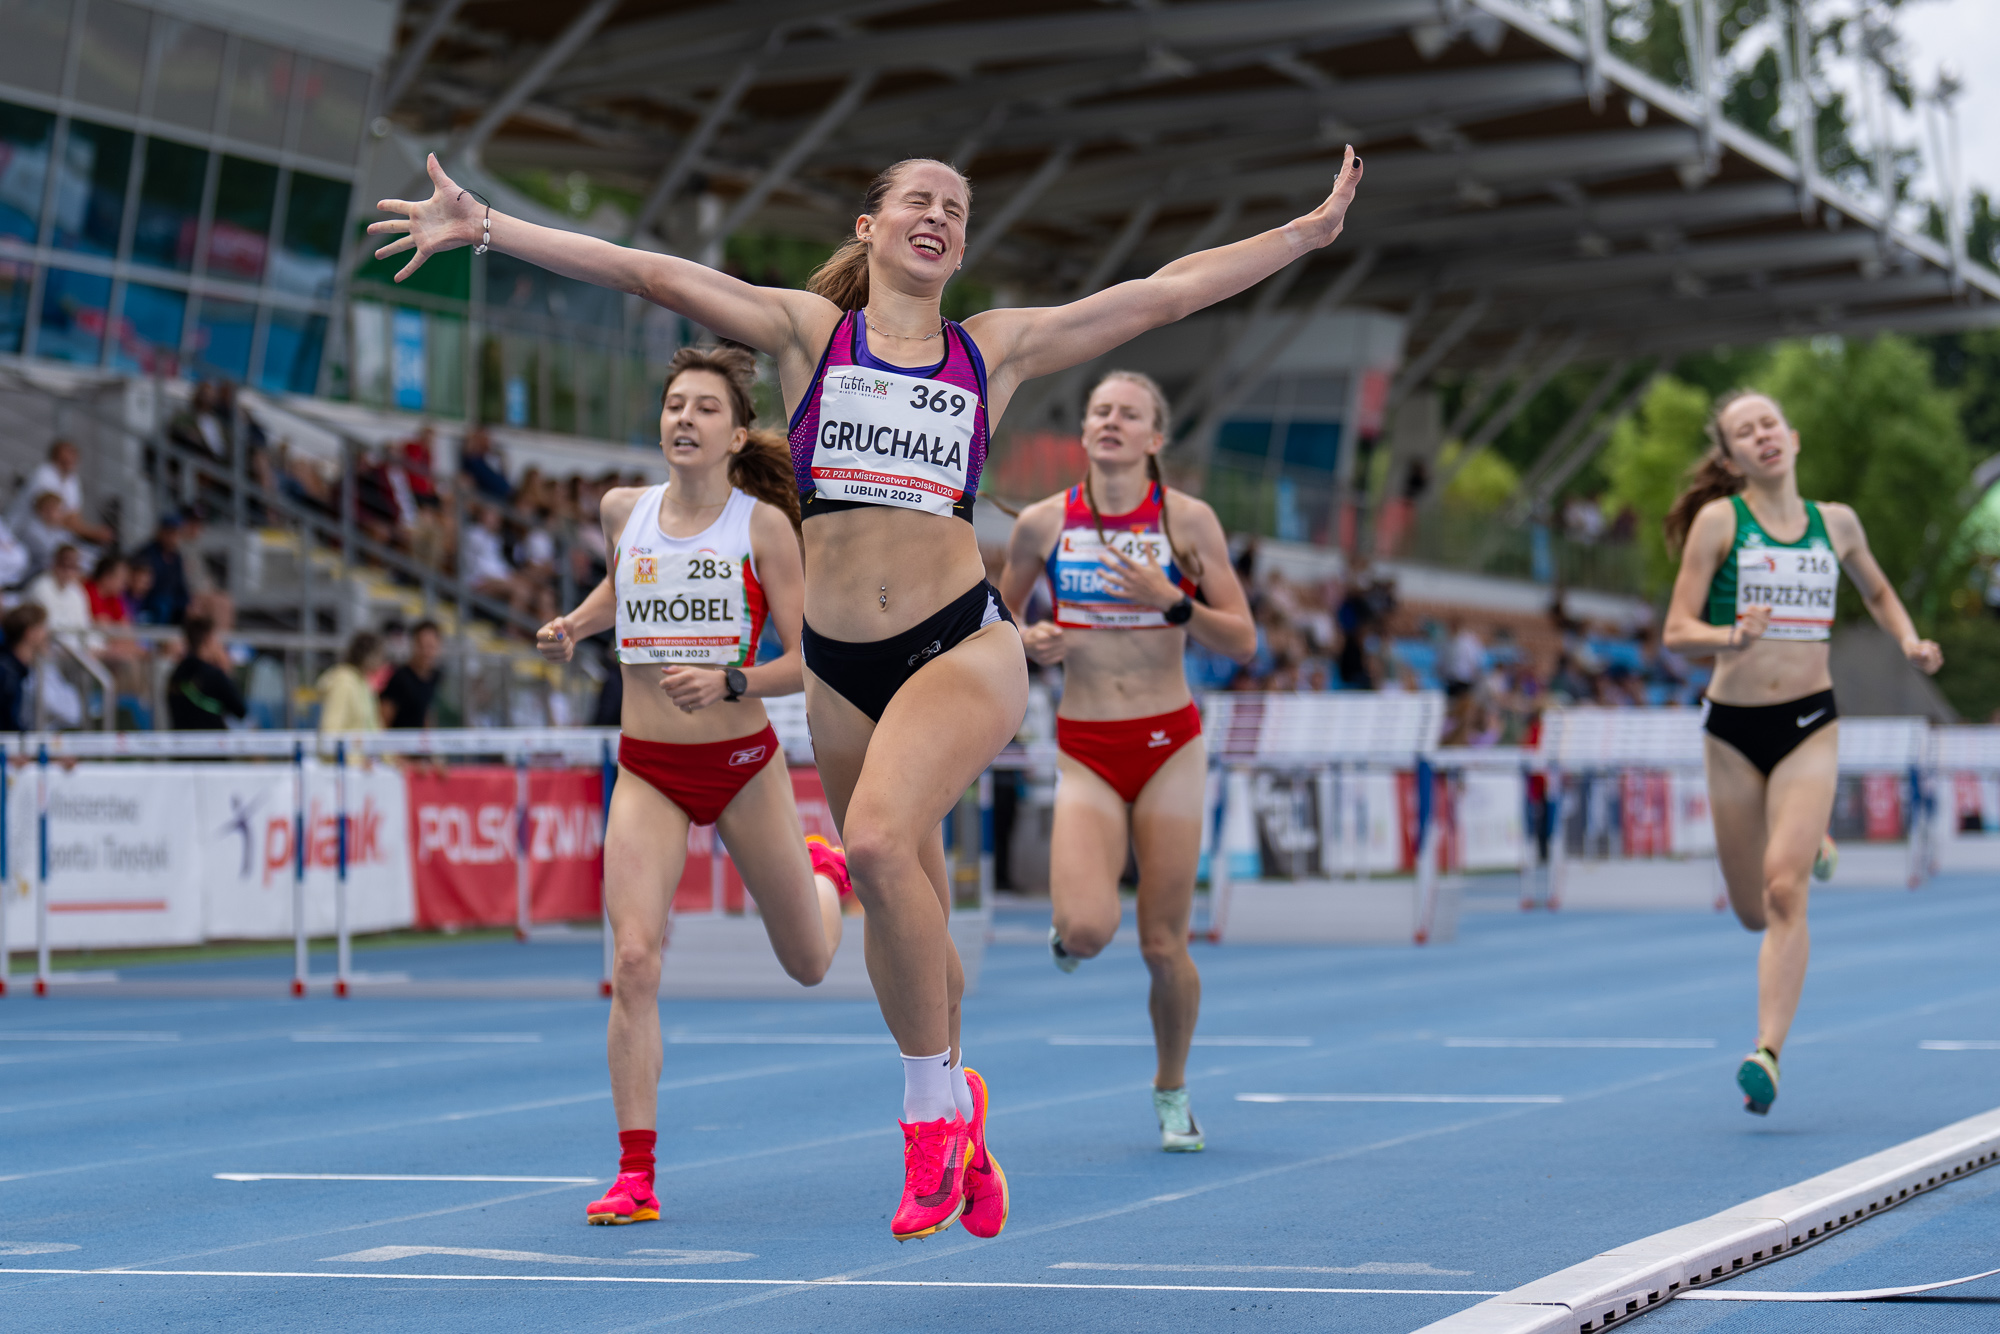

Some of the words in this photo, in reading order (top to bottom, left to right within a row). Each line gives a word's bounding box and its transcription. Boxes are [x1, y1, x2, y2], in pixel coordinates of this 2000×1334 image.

[830, 375, 872, 393] lublin
[910, 384, 966, 417] 369
[820, 419, 962, 472] GRUCHAŁA
[819, 469, 831, 478] 77.
[832, 470, 851, 479] PZLA
[853, 471, 908, 486] Mistrzostwa
[909, 479, 936, 492] Polski
[936, 486, 953, 497] U20
[843, 484, 887, 498] LUBLIN
[889, 490, 922, 503] 2023
[687, 558, 732, 580] 283
[1797, 556, 1830, 574] 216
[1742, 579, 1833, 607] STRZEŻYSZ
[626, 593, 734, 623] WRÓBEL
[653, 638, 697, 646] Mistrzostwa
[698, 637, 719, 646] Polski
[648, 649, 682, 658] LUBLIN
[684, 649, 710, 658] 2023
